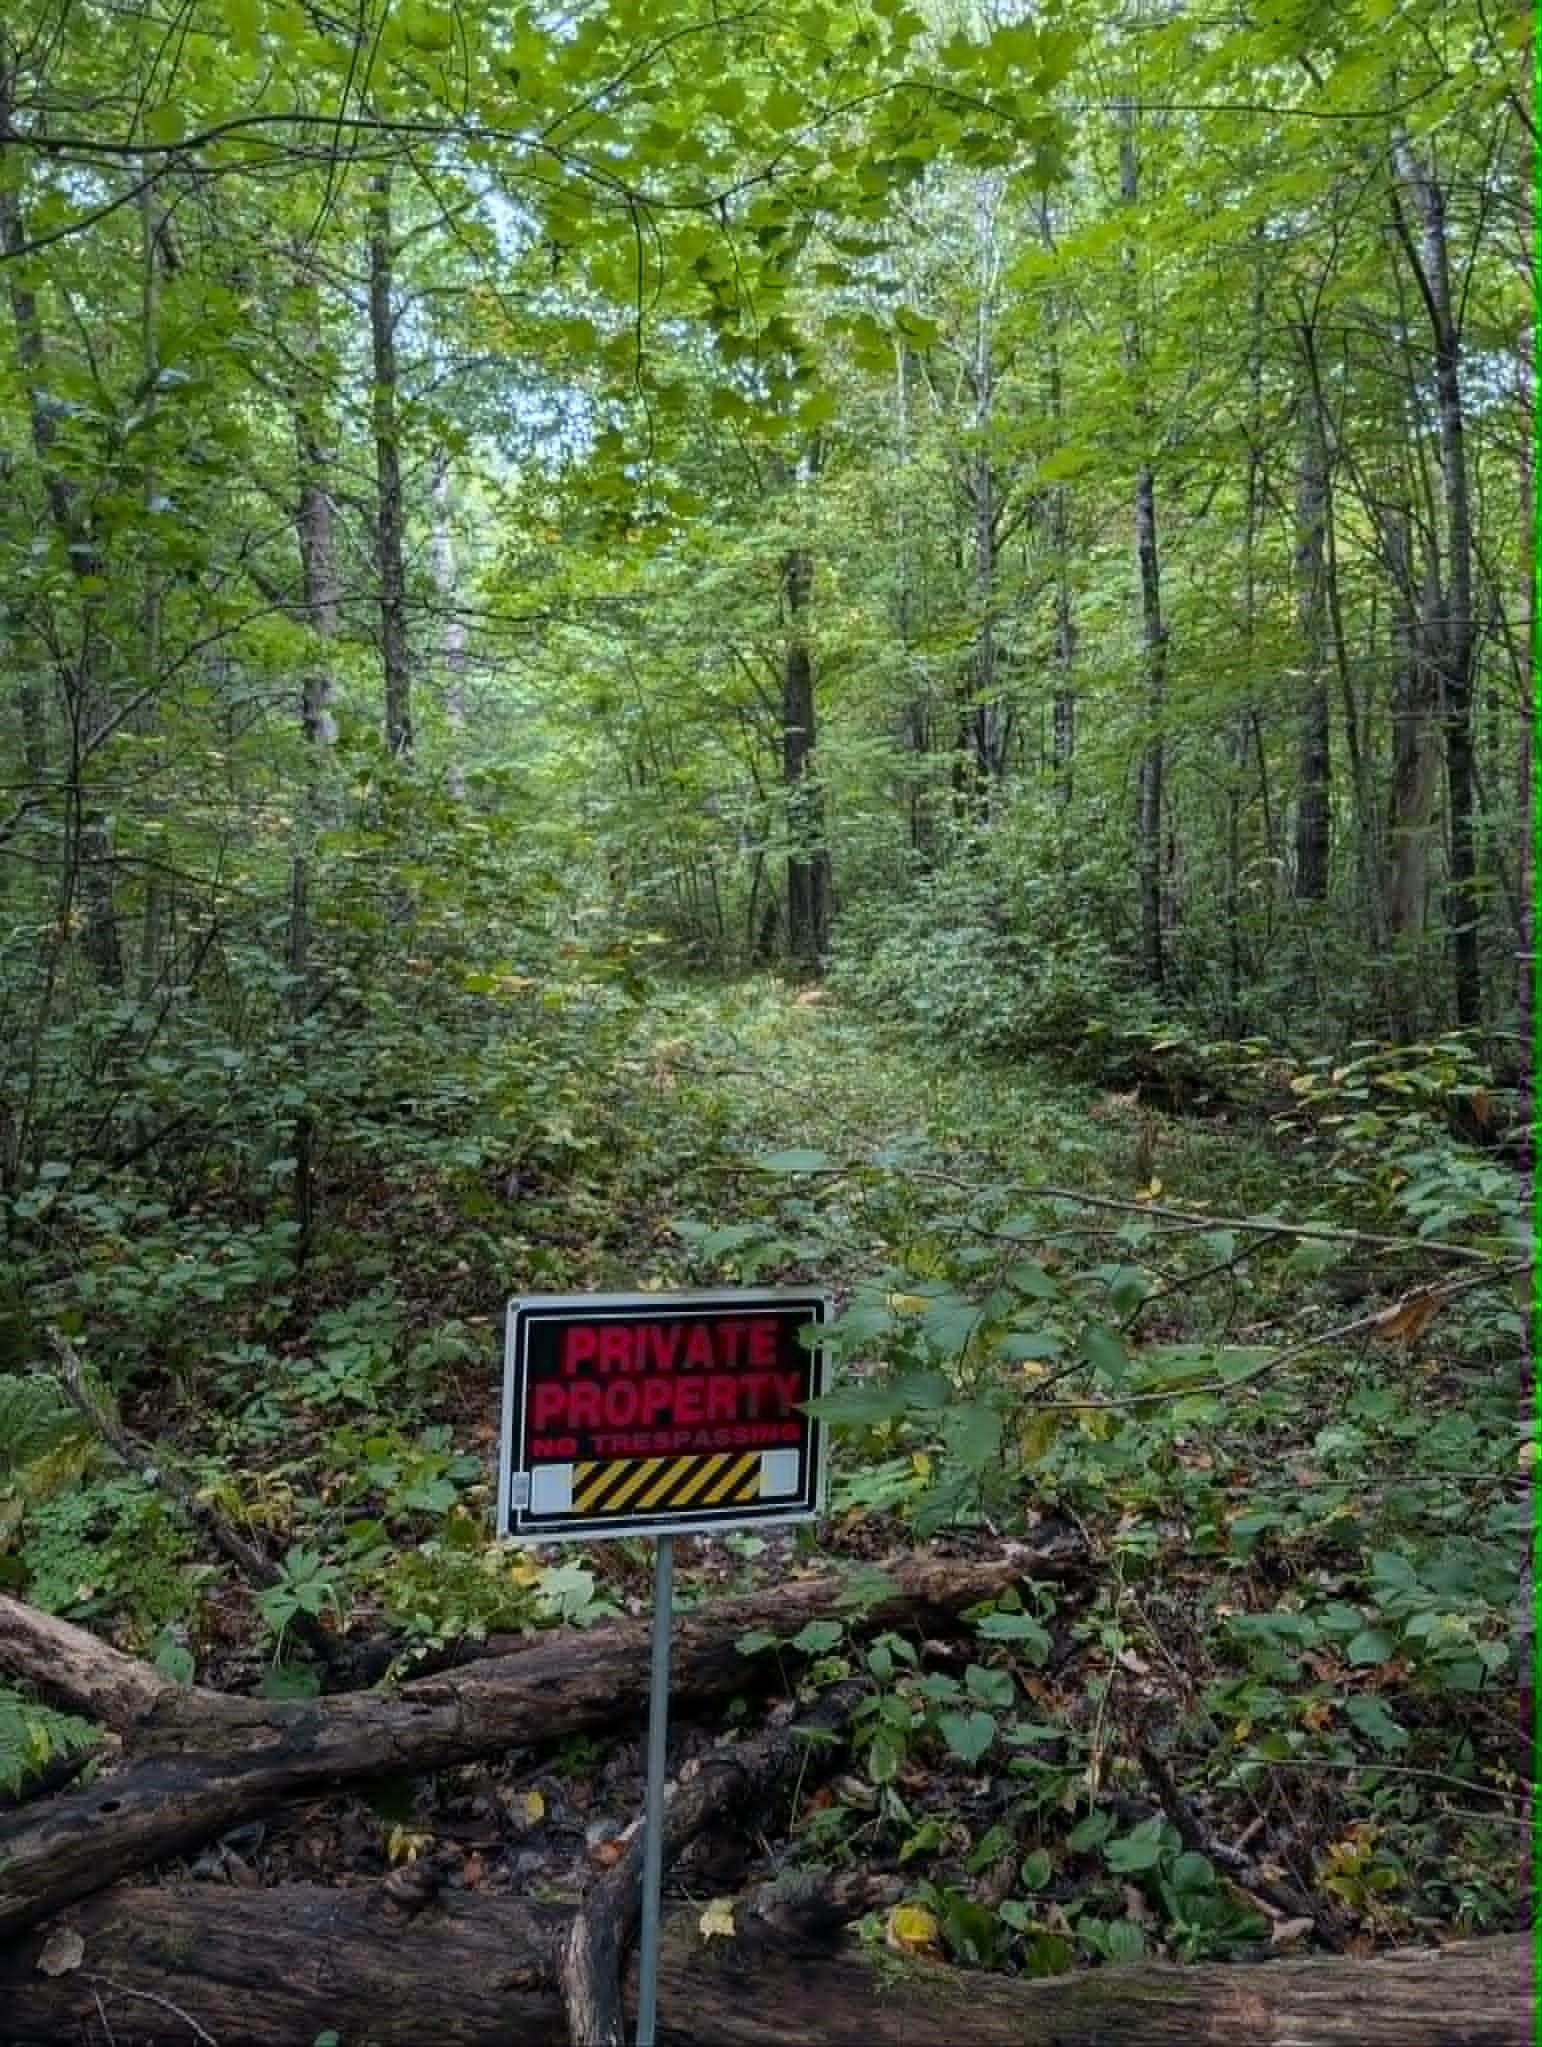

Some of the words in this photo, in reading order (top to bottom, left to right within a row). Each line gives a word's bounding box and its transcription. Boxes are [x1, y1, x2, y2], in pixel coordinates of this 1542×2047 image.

[564, 1320, 778, 1375] PRIVATE
[534, 1372, 800, 1428] PROPERTY
[533, 1439, 577, 1457] NO
[592, 1424, 800, 1451] TRESPASSING
